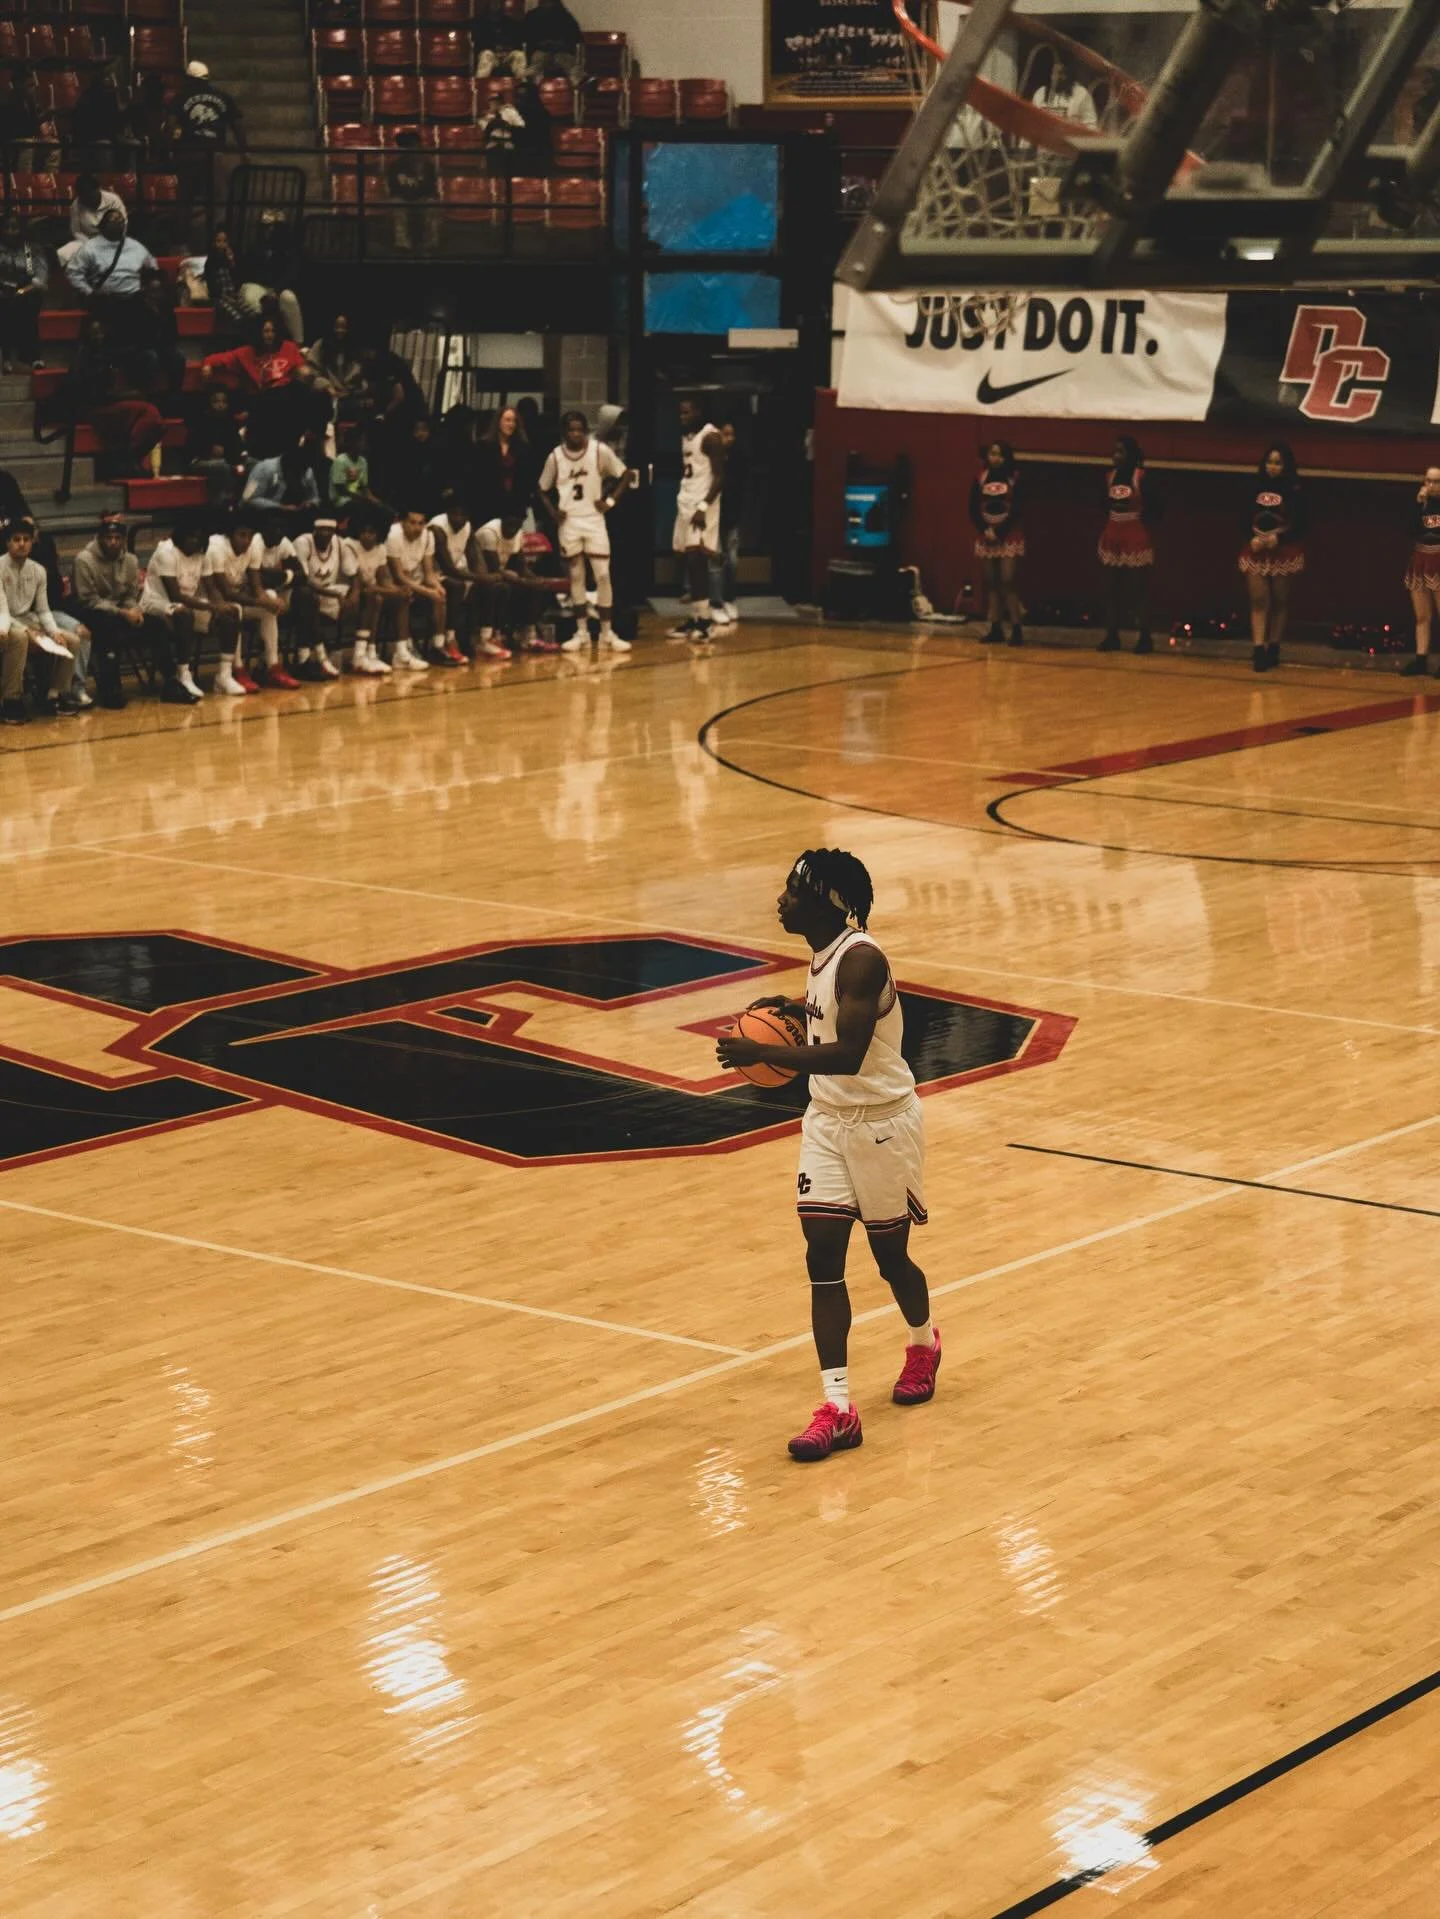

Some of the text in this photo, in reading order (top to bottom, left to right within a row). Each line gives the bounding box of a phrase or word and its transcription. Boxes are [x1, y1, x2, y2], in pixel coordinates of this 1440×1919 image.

[1024, 297, 1093, 353] DO
[1101, 299, 1158, 356] IT.
[1279, 304, 1391, 423] DC
[573, 484, 584, 501] 3
